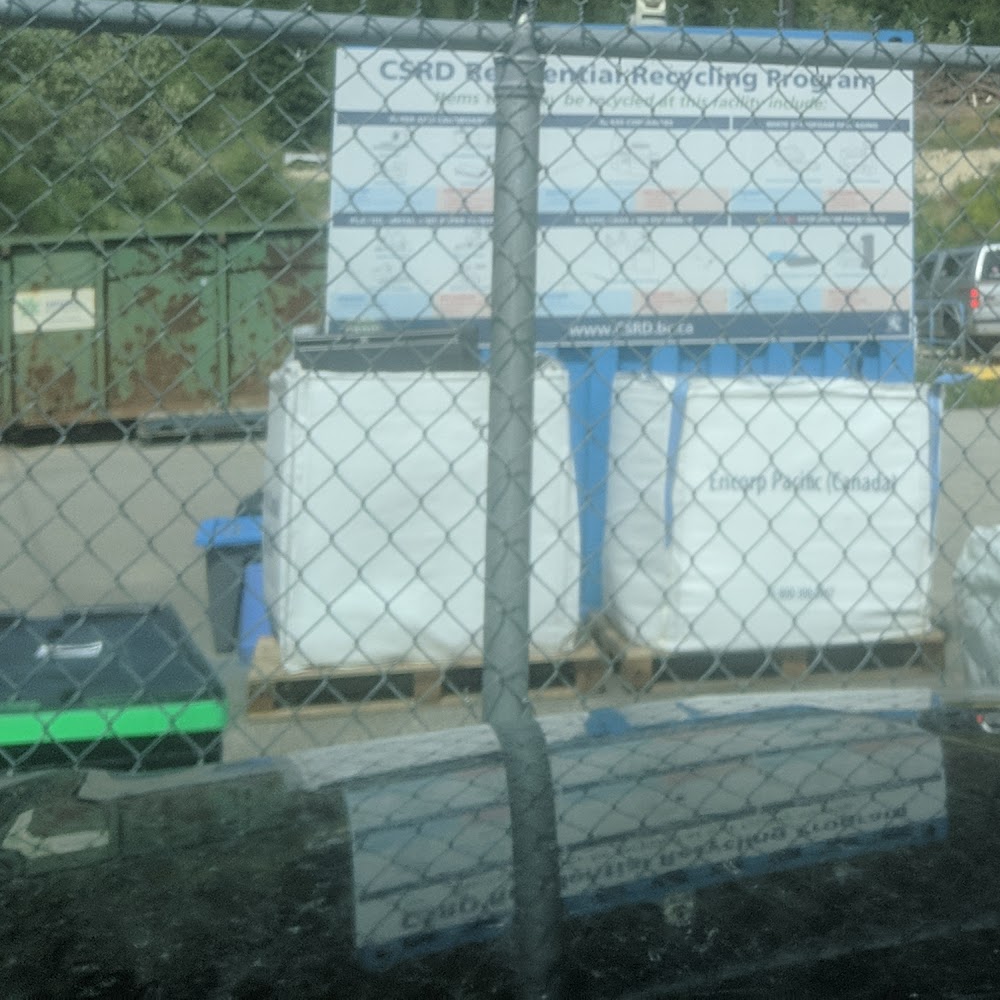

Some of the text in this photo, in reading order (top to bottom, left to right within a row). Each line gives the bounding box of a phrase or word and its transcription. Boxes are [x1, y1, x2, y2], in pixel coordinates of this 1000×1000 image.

[379, 60, 877, 94] CSRD Reential Recycling Program
[709, 472, 767, 495] Encorp
[772, 470, 821, 492] Pacific
